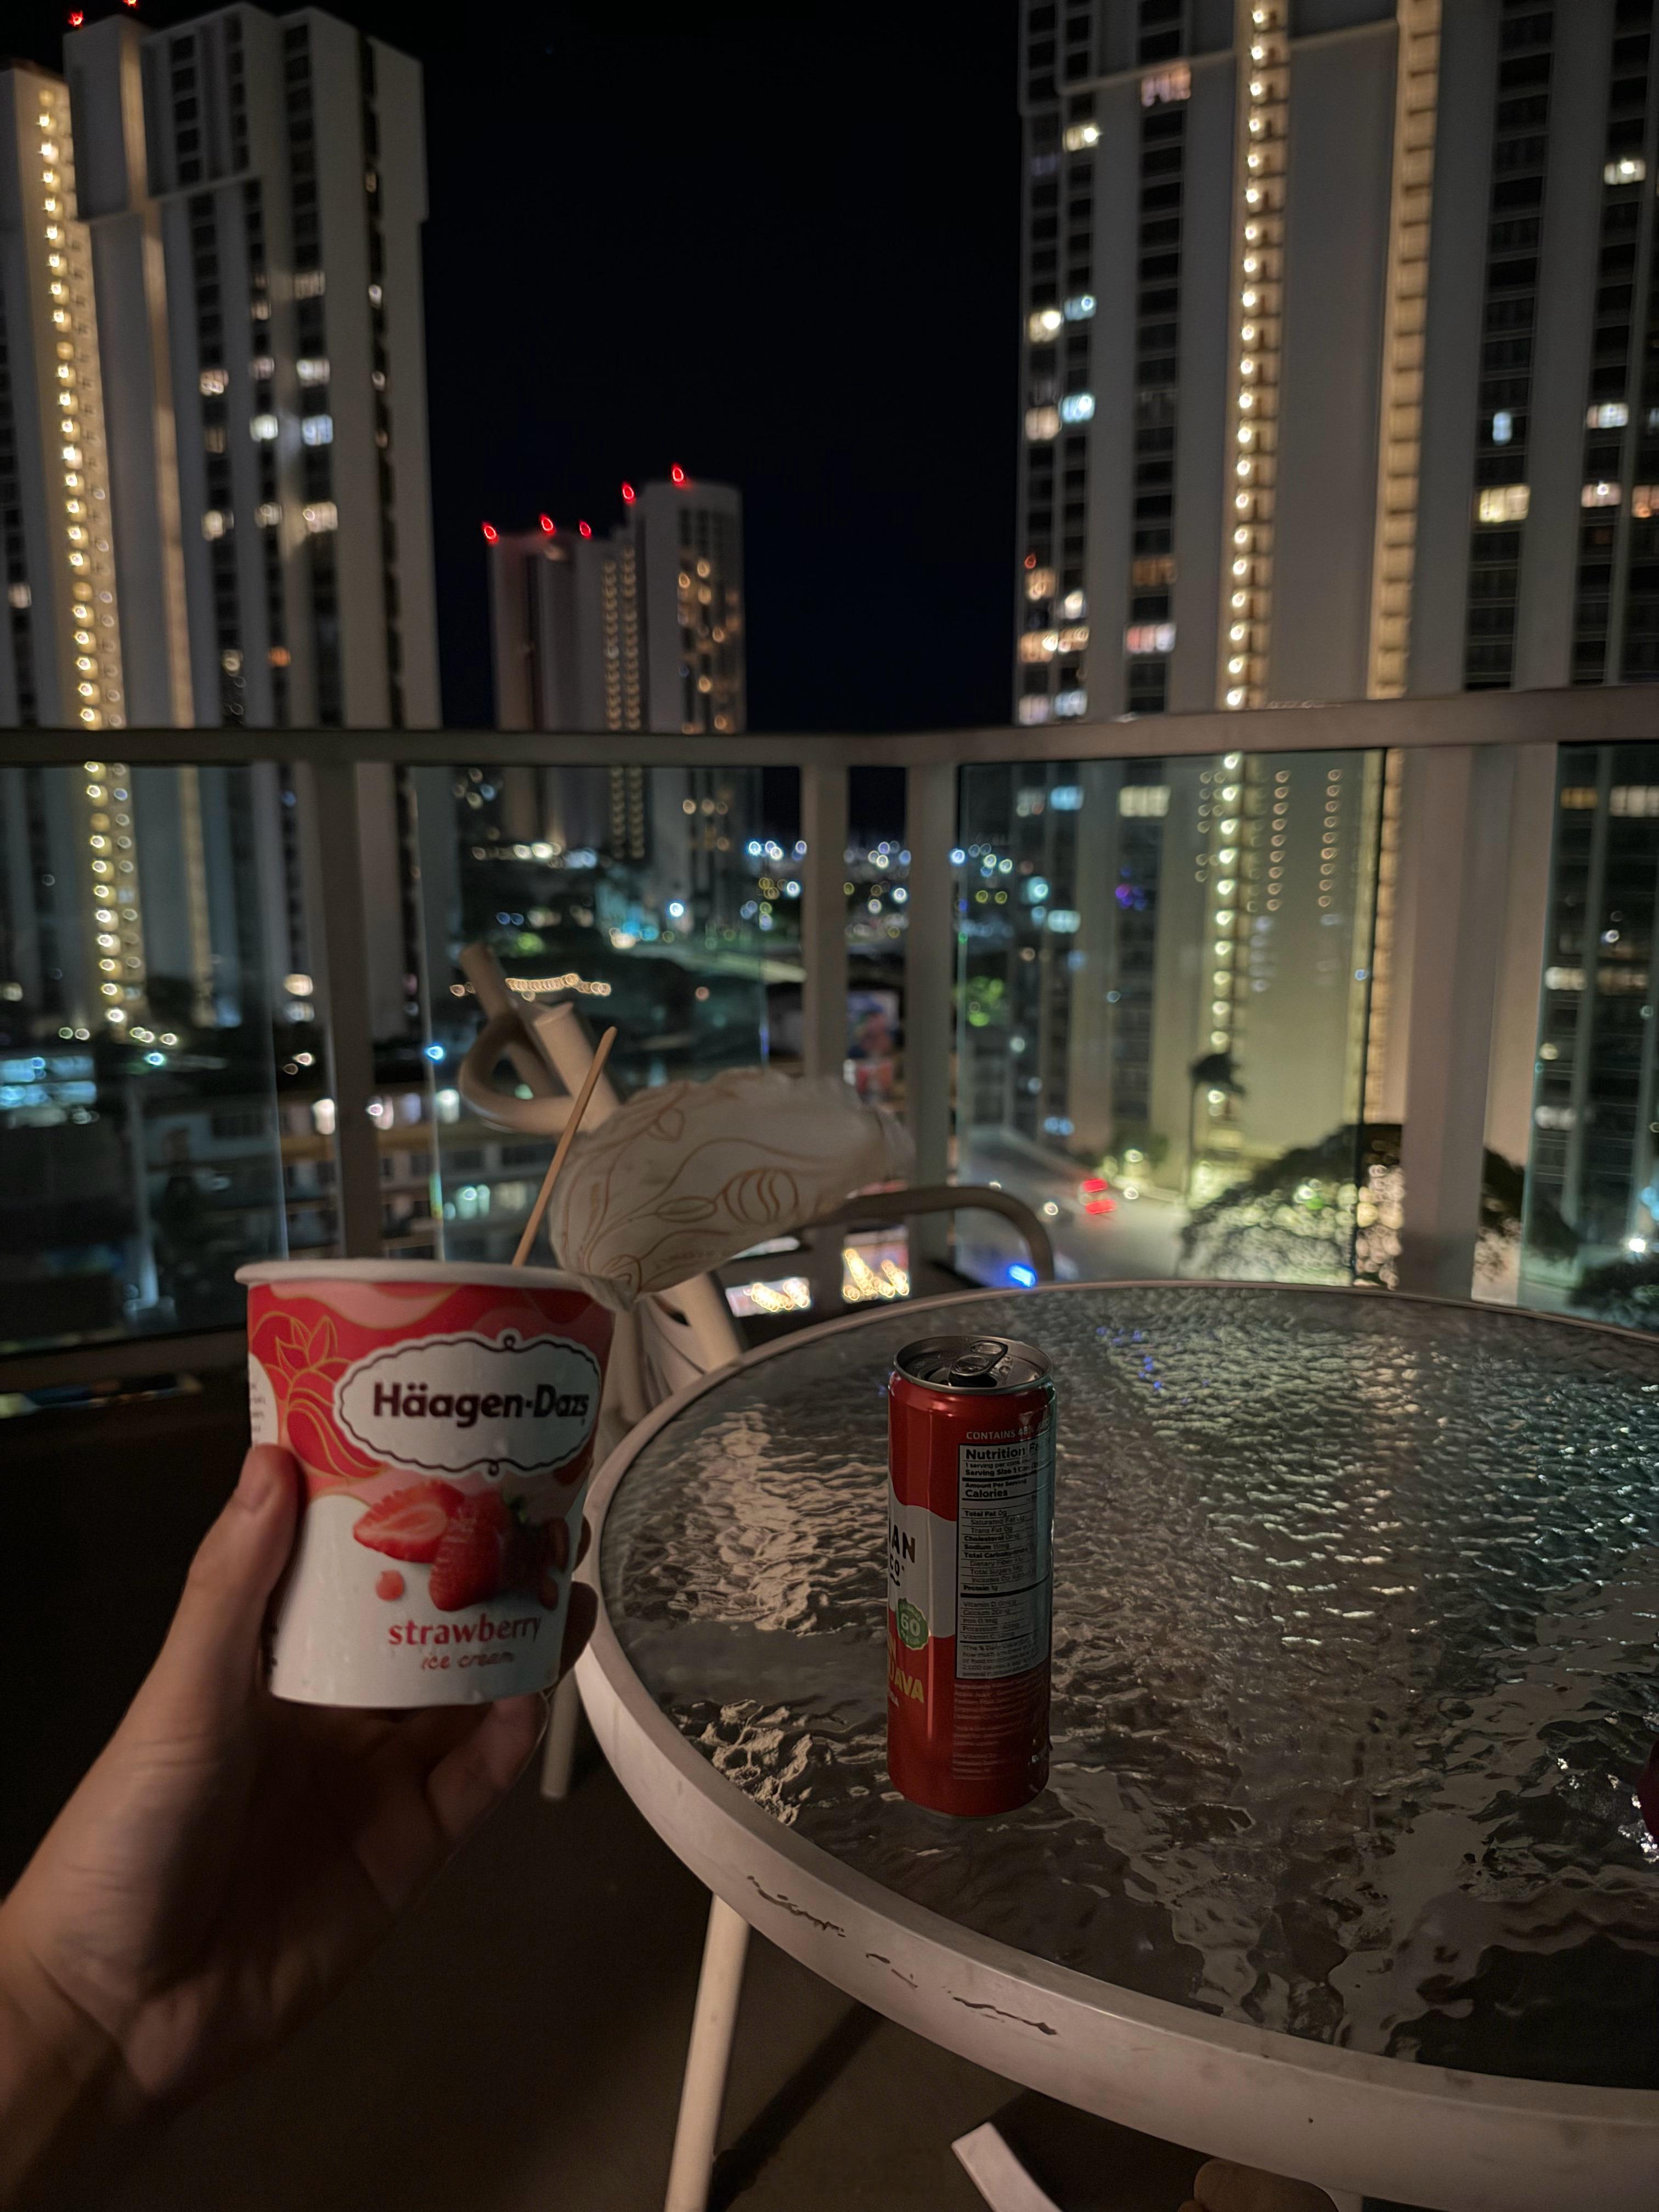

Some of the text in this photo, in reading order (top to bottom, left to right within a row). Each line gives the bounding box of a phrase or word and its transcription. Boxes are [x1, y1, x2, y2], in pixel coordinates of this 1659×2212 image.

[966, 1430, 1015, 1440] CONTAINS
[966, 1446, 1025, 1459] Nutrition
[965, 1489, 1008, 1498] Calories
[388, 1612, 542, 1645] strawberry
[901, 1613, 921, 1637] 60
[421, 1651, 515, 1669] ice cream
